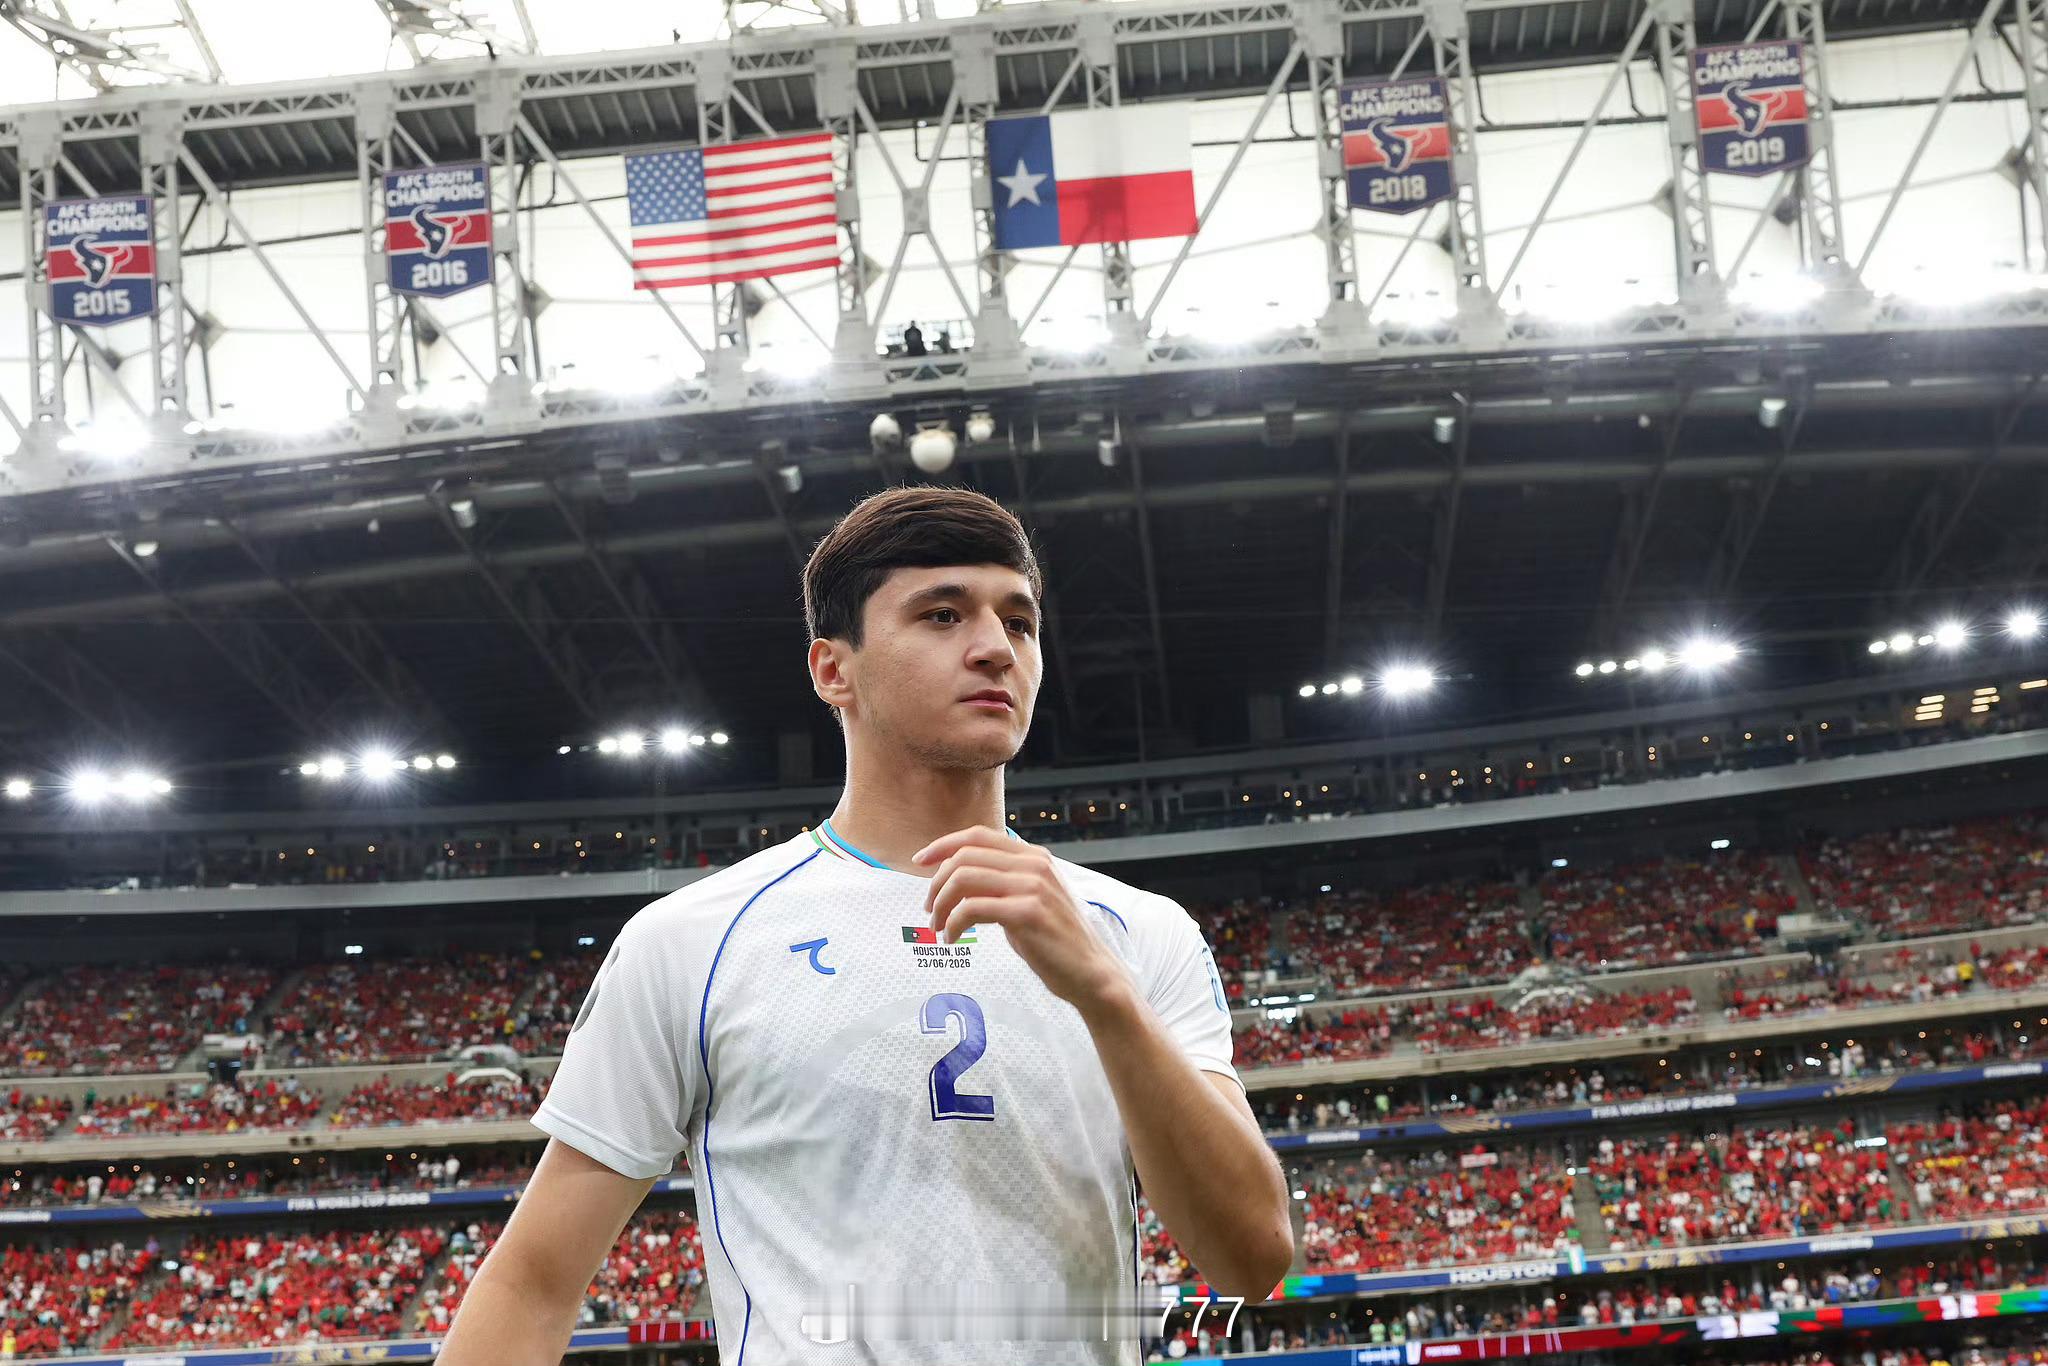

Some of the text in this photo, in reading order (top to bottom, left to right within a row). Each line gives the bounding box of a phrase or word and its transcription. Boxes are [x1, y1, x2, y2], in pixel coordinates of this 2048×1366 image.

[1707, 46, 1788, 65] AFC SOUTH
[1695, 57, 1800, 84] CHAMPIONS
[1352, 84, 1431, 102] AFC SOUTH
[1341, 96, 1444, 120] CHAMPIONS
[1726, 137, 1785, 168] 2019
[397, 170, 474, 189] AFC SOUTH
[1369, 174, 1427, 204] 2018
[386, 182, 485, 207] CHAMPIONS
[58, 201, 137, 218] AFC SOUTH
[47, 213, 149, 236] CHAMPIONS
[411, 260, 468, 289] 2016
[73, 289, 131, 317] 2015
[954, 946, 971, 956] USA
[917, 958, 971, 968] 23/06/2026
[919, 992, 995, 1121] 2
[1450, 1263, 1557, 1284] HOUSTON
